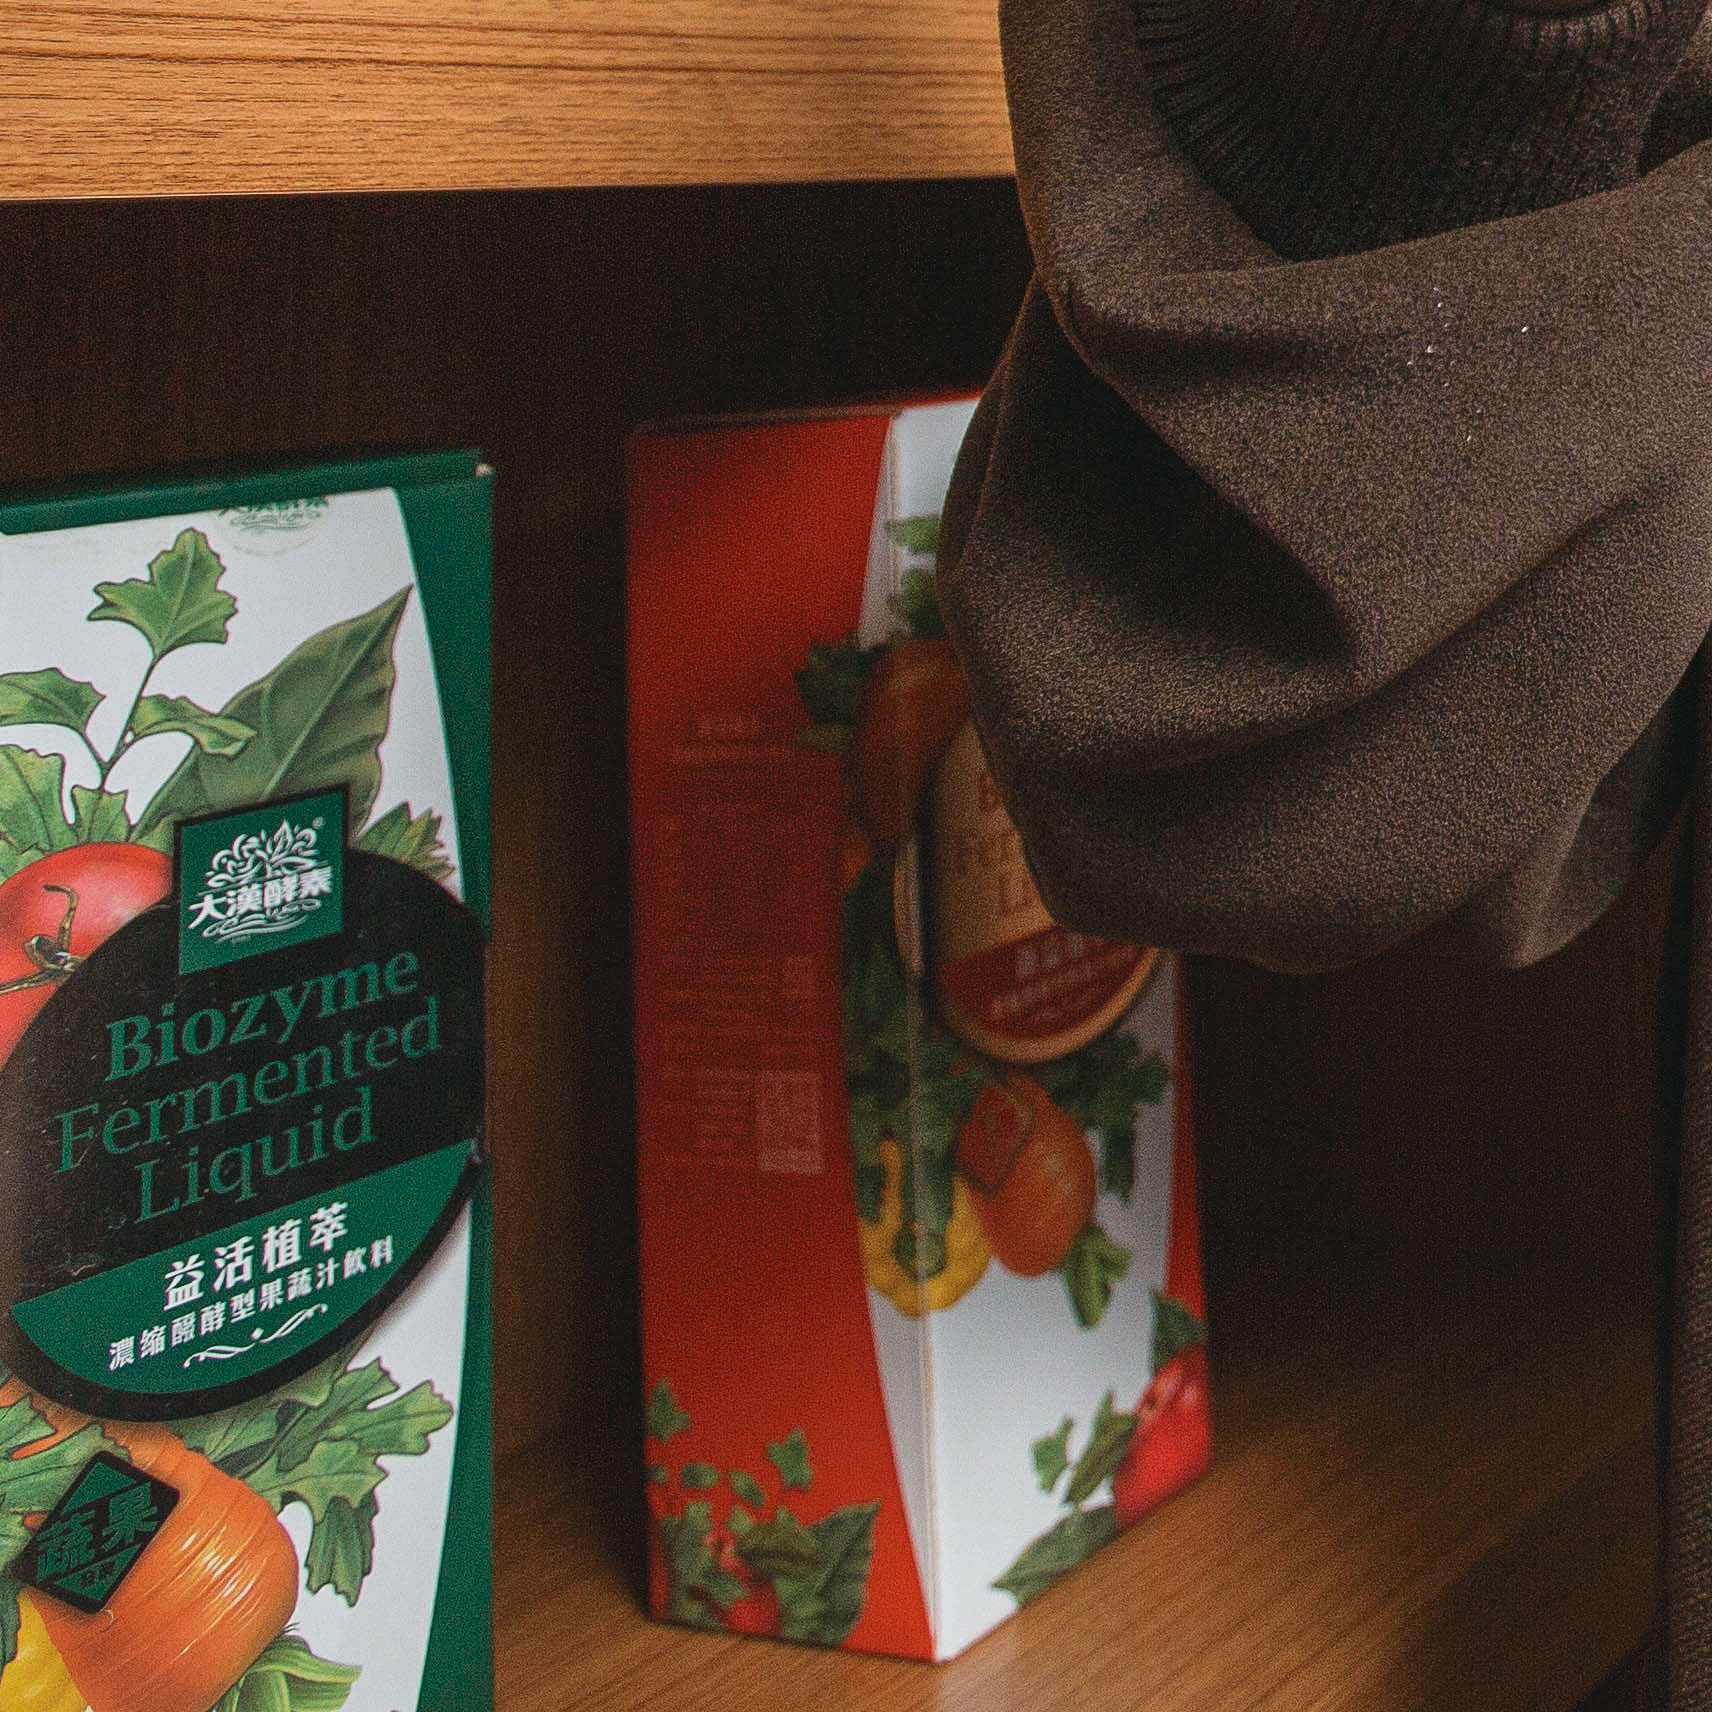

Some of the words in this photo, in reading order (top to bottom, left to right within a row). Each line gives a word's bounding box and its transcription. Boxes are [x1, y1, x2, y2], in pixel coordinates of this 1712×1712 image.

[104, 950, 419, 1082] Biozyme
[54, 995, 442, 1174] Fermented
[134, 1084, 376, 1224] Liquid
[163, 1201, 348, 1312] 益活植萃
